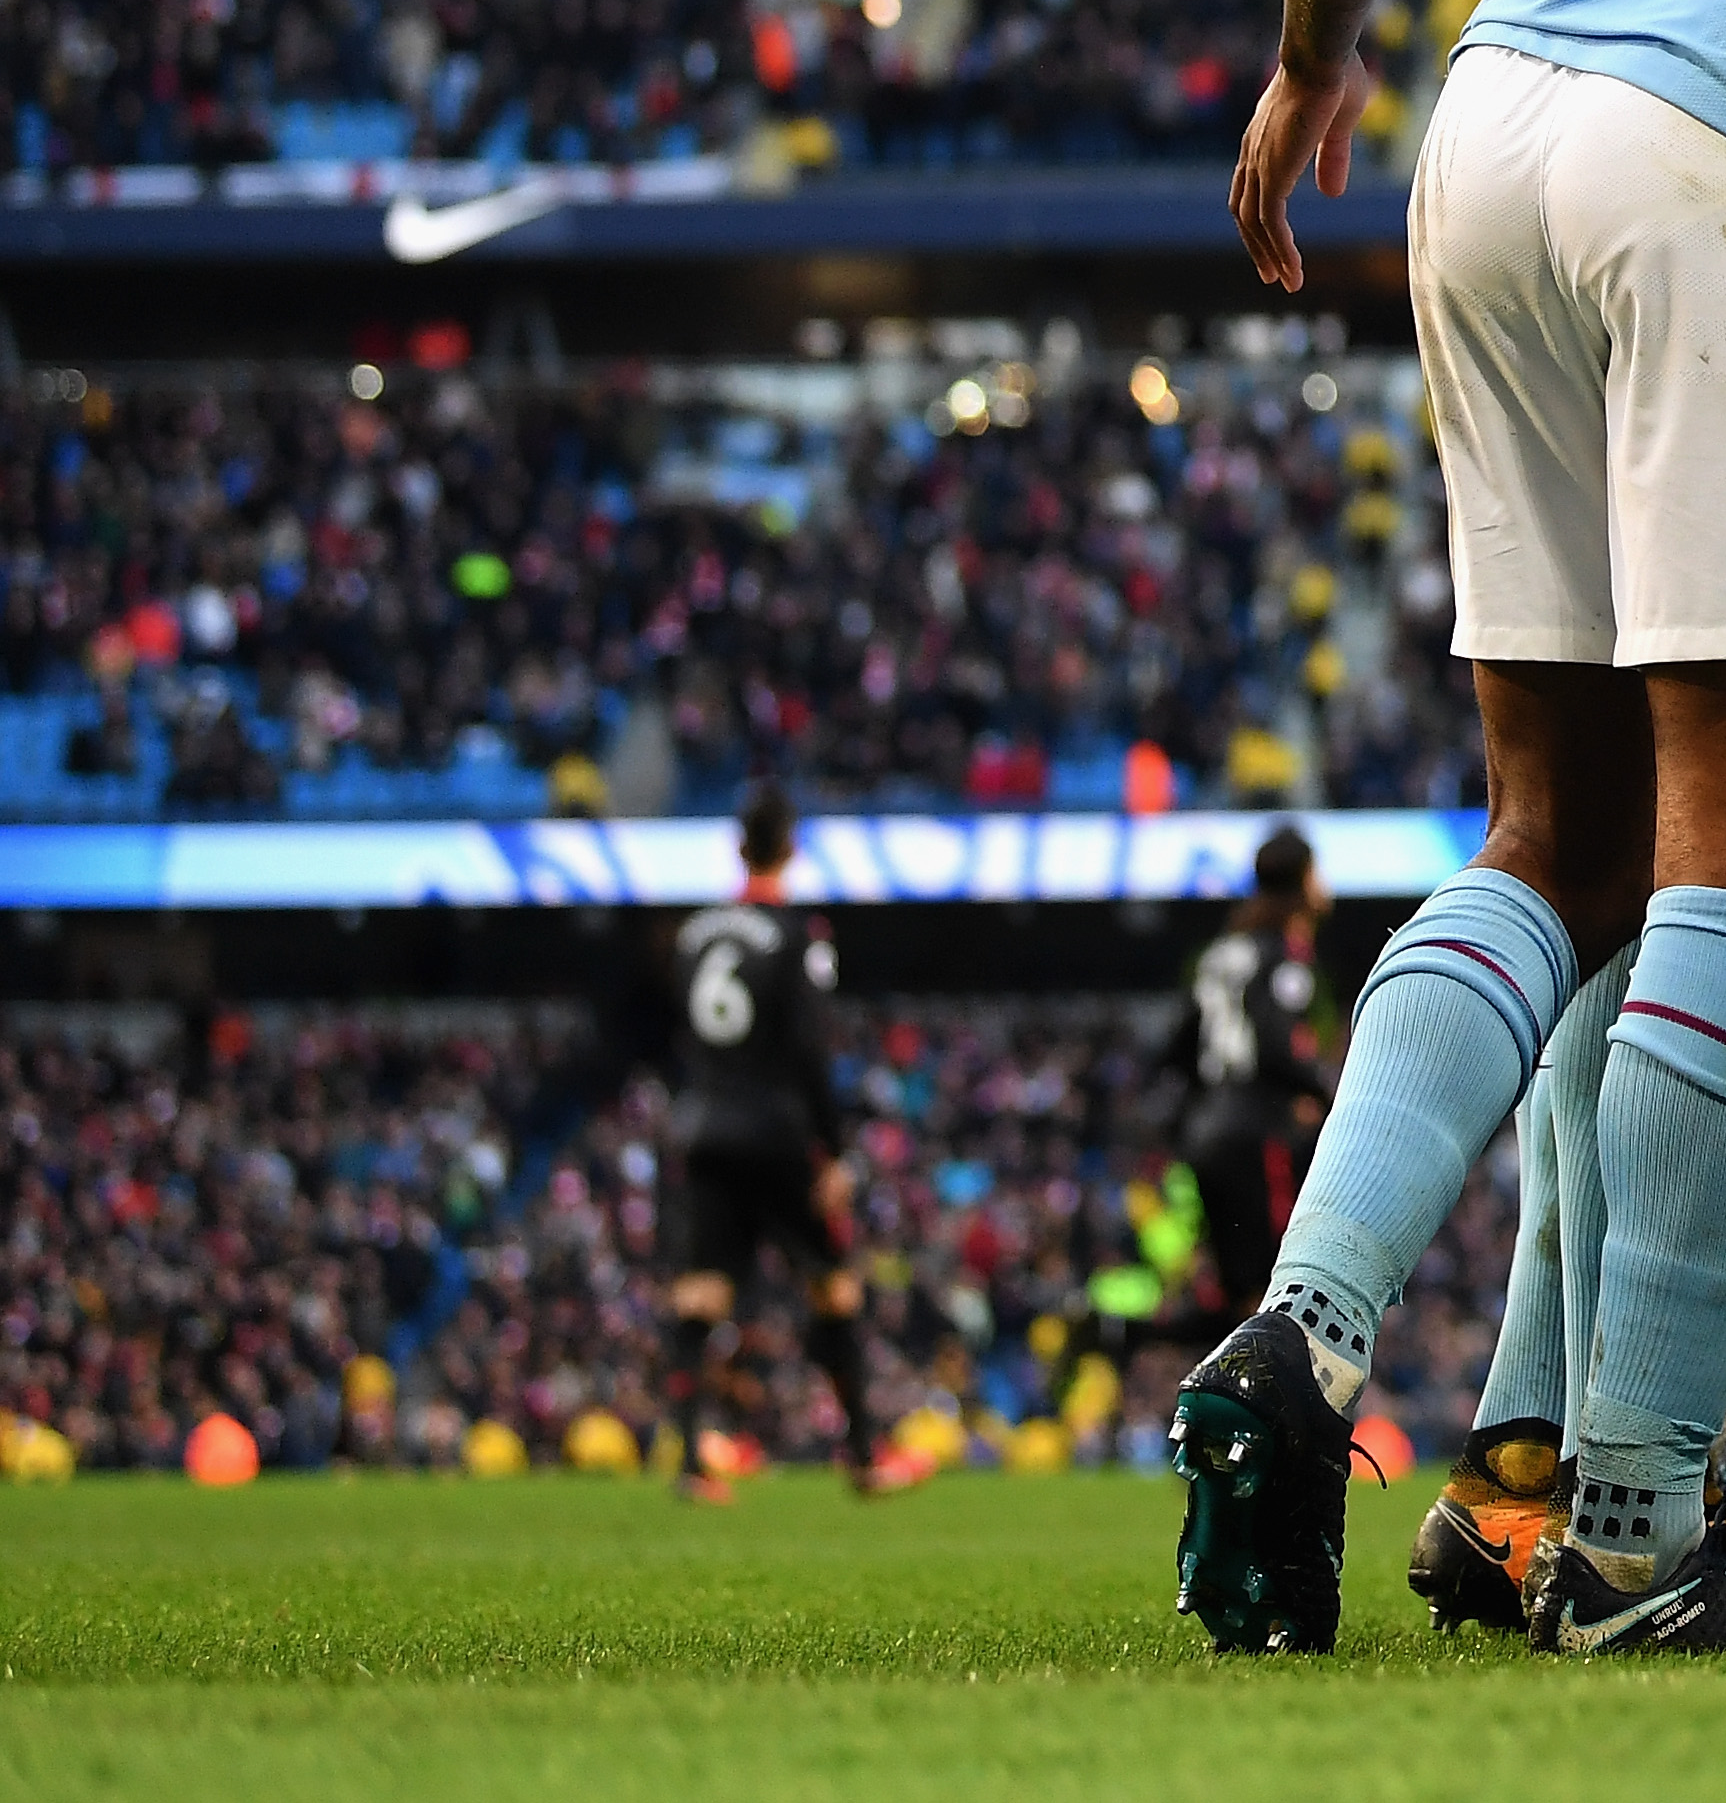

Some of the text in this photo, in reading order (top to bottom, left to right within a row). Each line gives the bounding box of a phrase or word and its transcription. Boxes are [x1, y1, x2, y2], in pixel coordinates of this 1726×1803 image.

[689, 941, 756, 1046] 6
[1651, 1597, 1686, 1625] UNRULY
[1653, 1601, 1706, 1641] AGO-ROMEO
